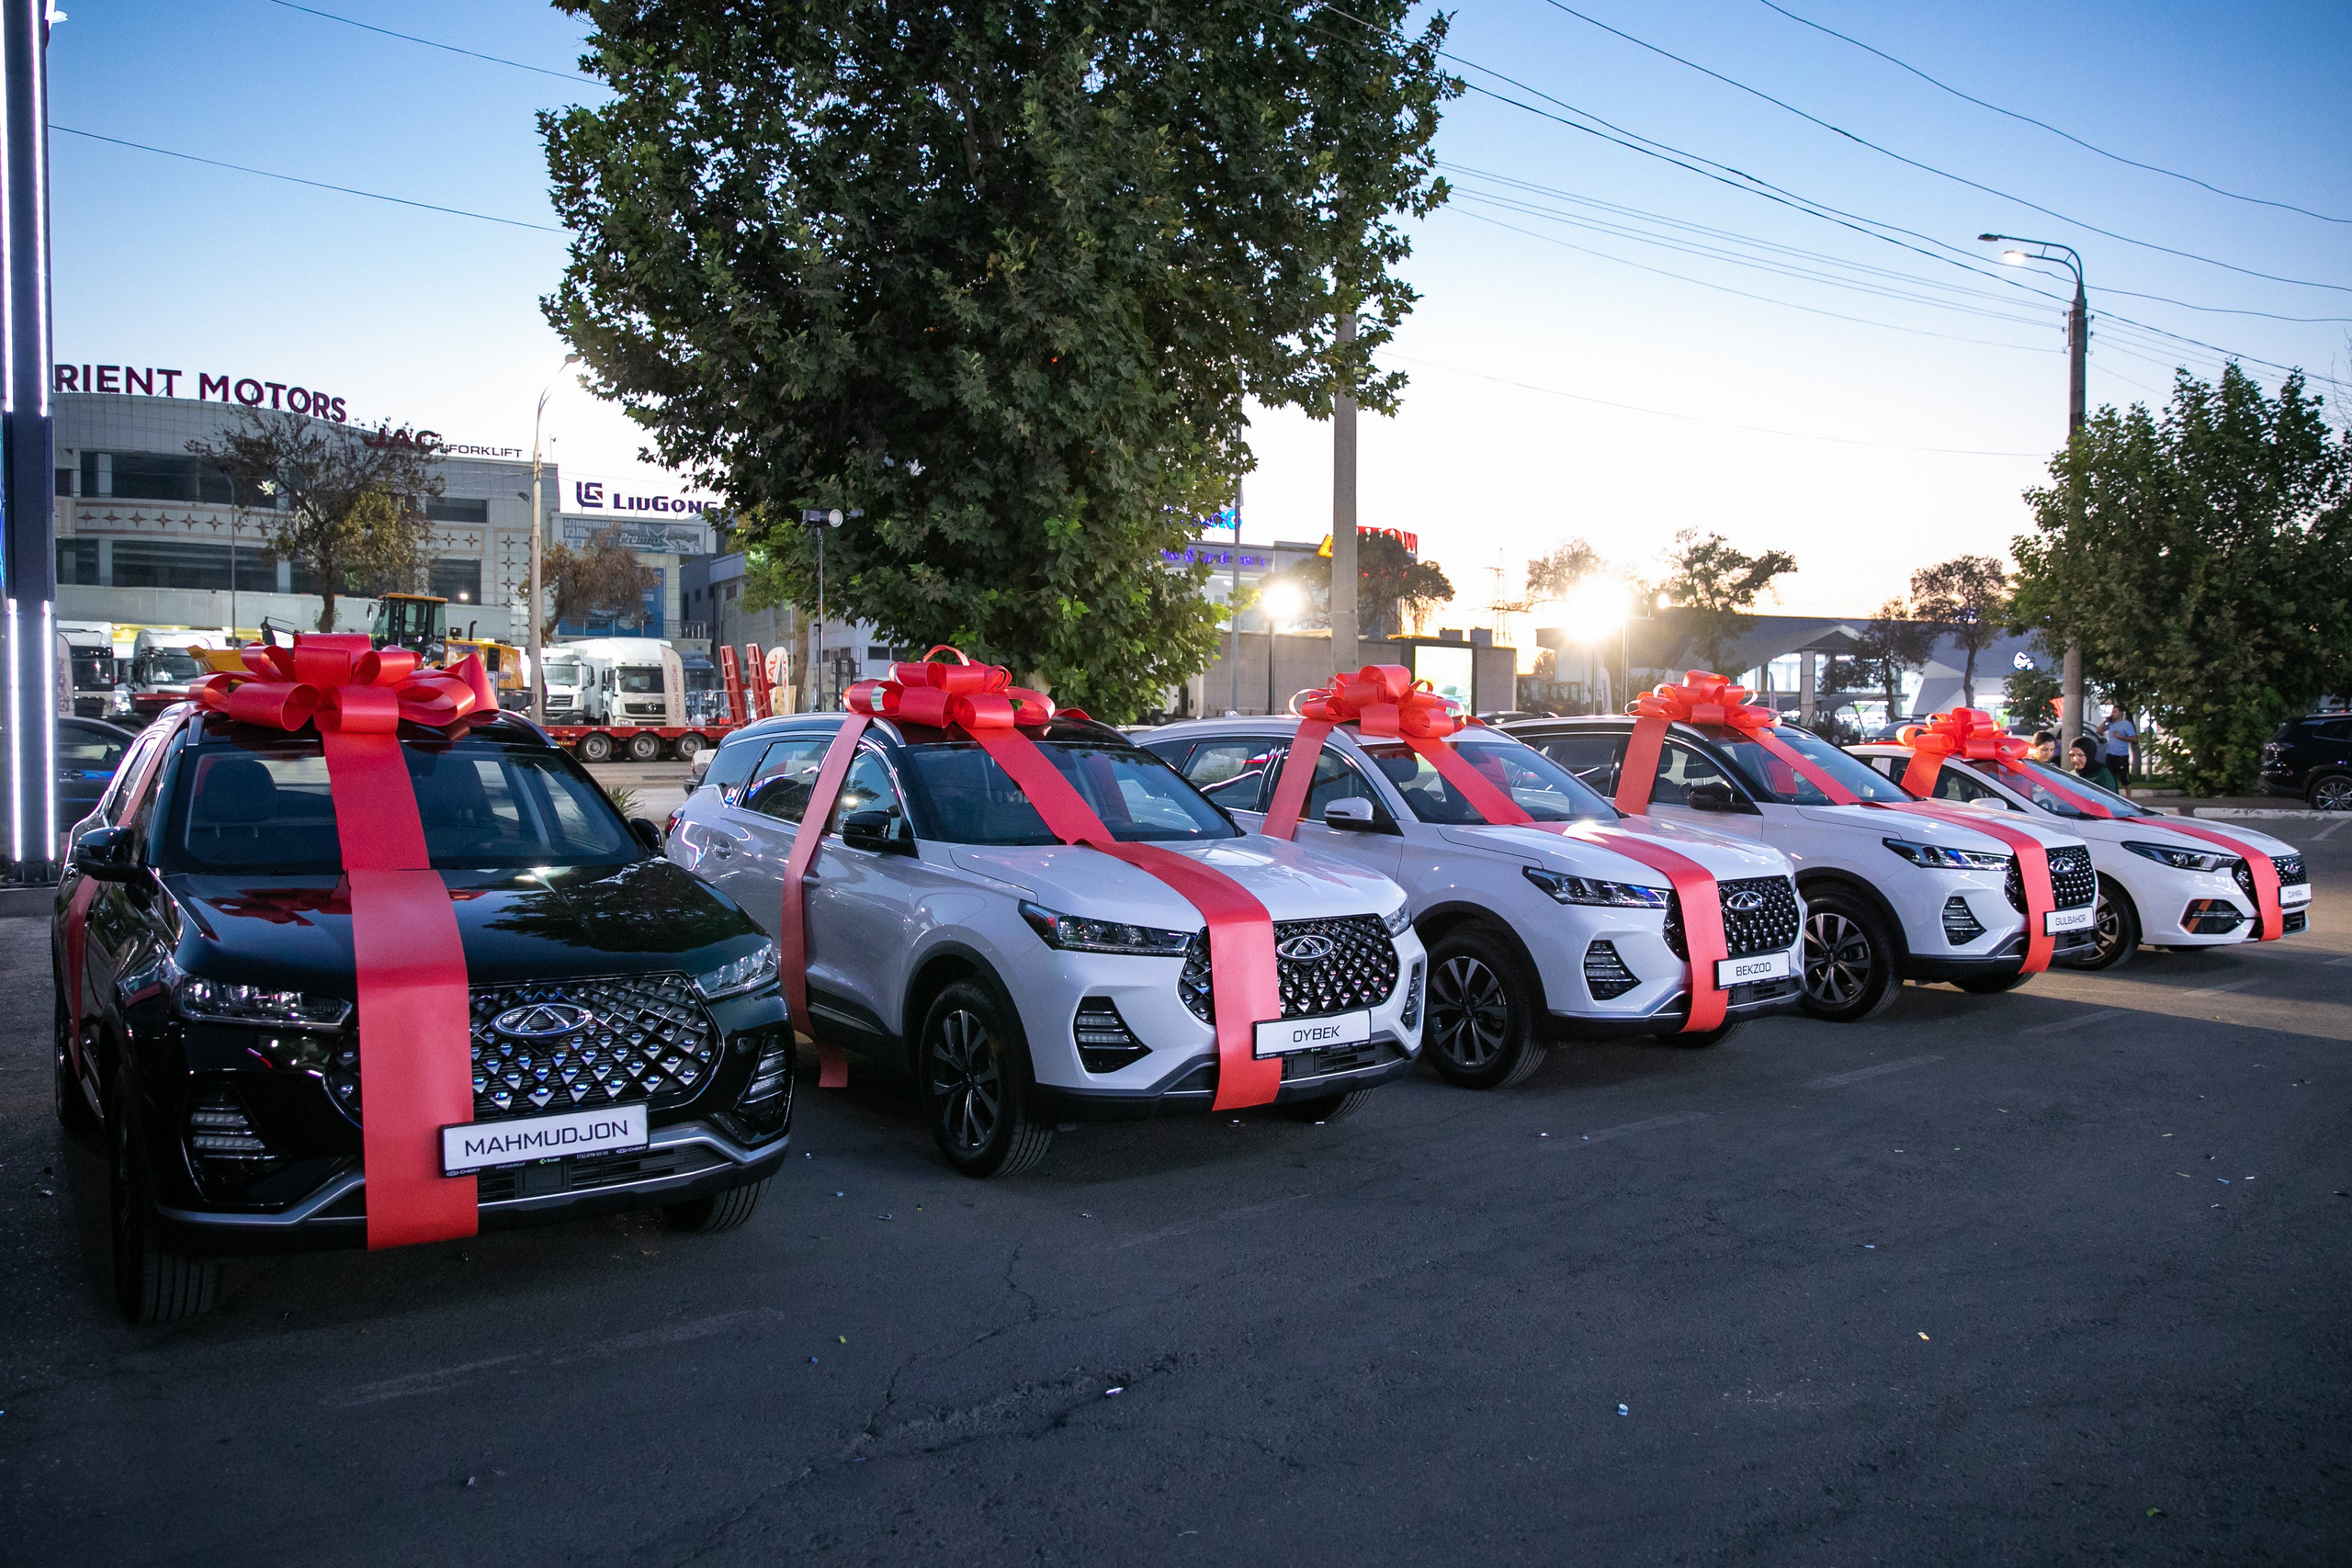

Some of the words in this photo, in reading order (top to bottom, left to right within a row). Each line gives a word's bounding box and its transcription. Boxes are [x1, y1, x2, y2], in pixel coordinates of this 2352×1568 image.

[54, 364, 182, 398] RIENT
[198, 372, 347, 423] MOTORS
[448, 444, 523, 458] FORKLIFT
[1736, 962, 1771, 976] BEKZOD
[1293, 1024, 1341, 1043] OYBEK
[465, 1120, 628, 1156] MAHMUDJON
